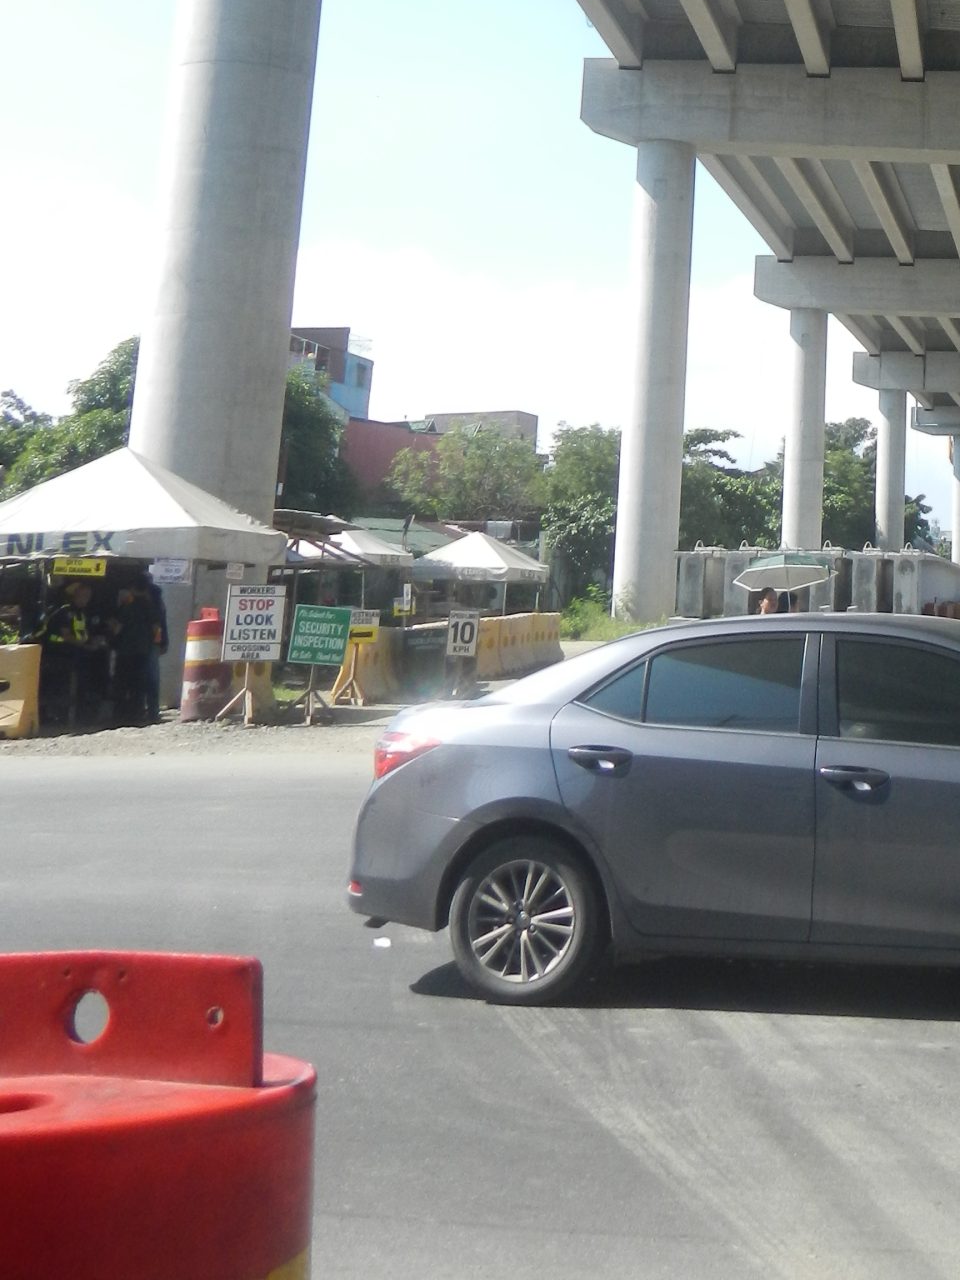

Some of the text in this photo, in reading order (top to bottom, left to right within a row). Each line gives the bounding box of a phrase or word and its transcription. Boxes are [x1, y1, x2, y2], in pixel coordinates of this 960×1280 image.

[239, 586, 275, 594] WORKERS
[238, 598, 275, 611] STOP
[235, 613, 275, 626] LOOK
[230, 628, 276, 641] LISTEN
[298, 621, 344, 636] SECURITY
[451, 621, 475, 644] 10
[230, 644, 271, 652] CROSSING
[293, 634, 345, 650] INSPECTION
